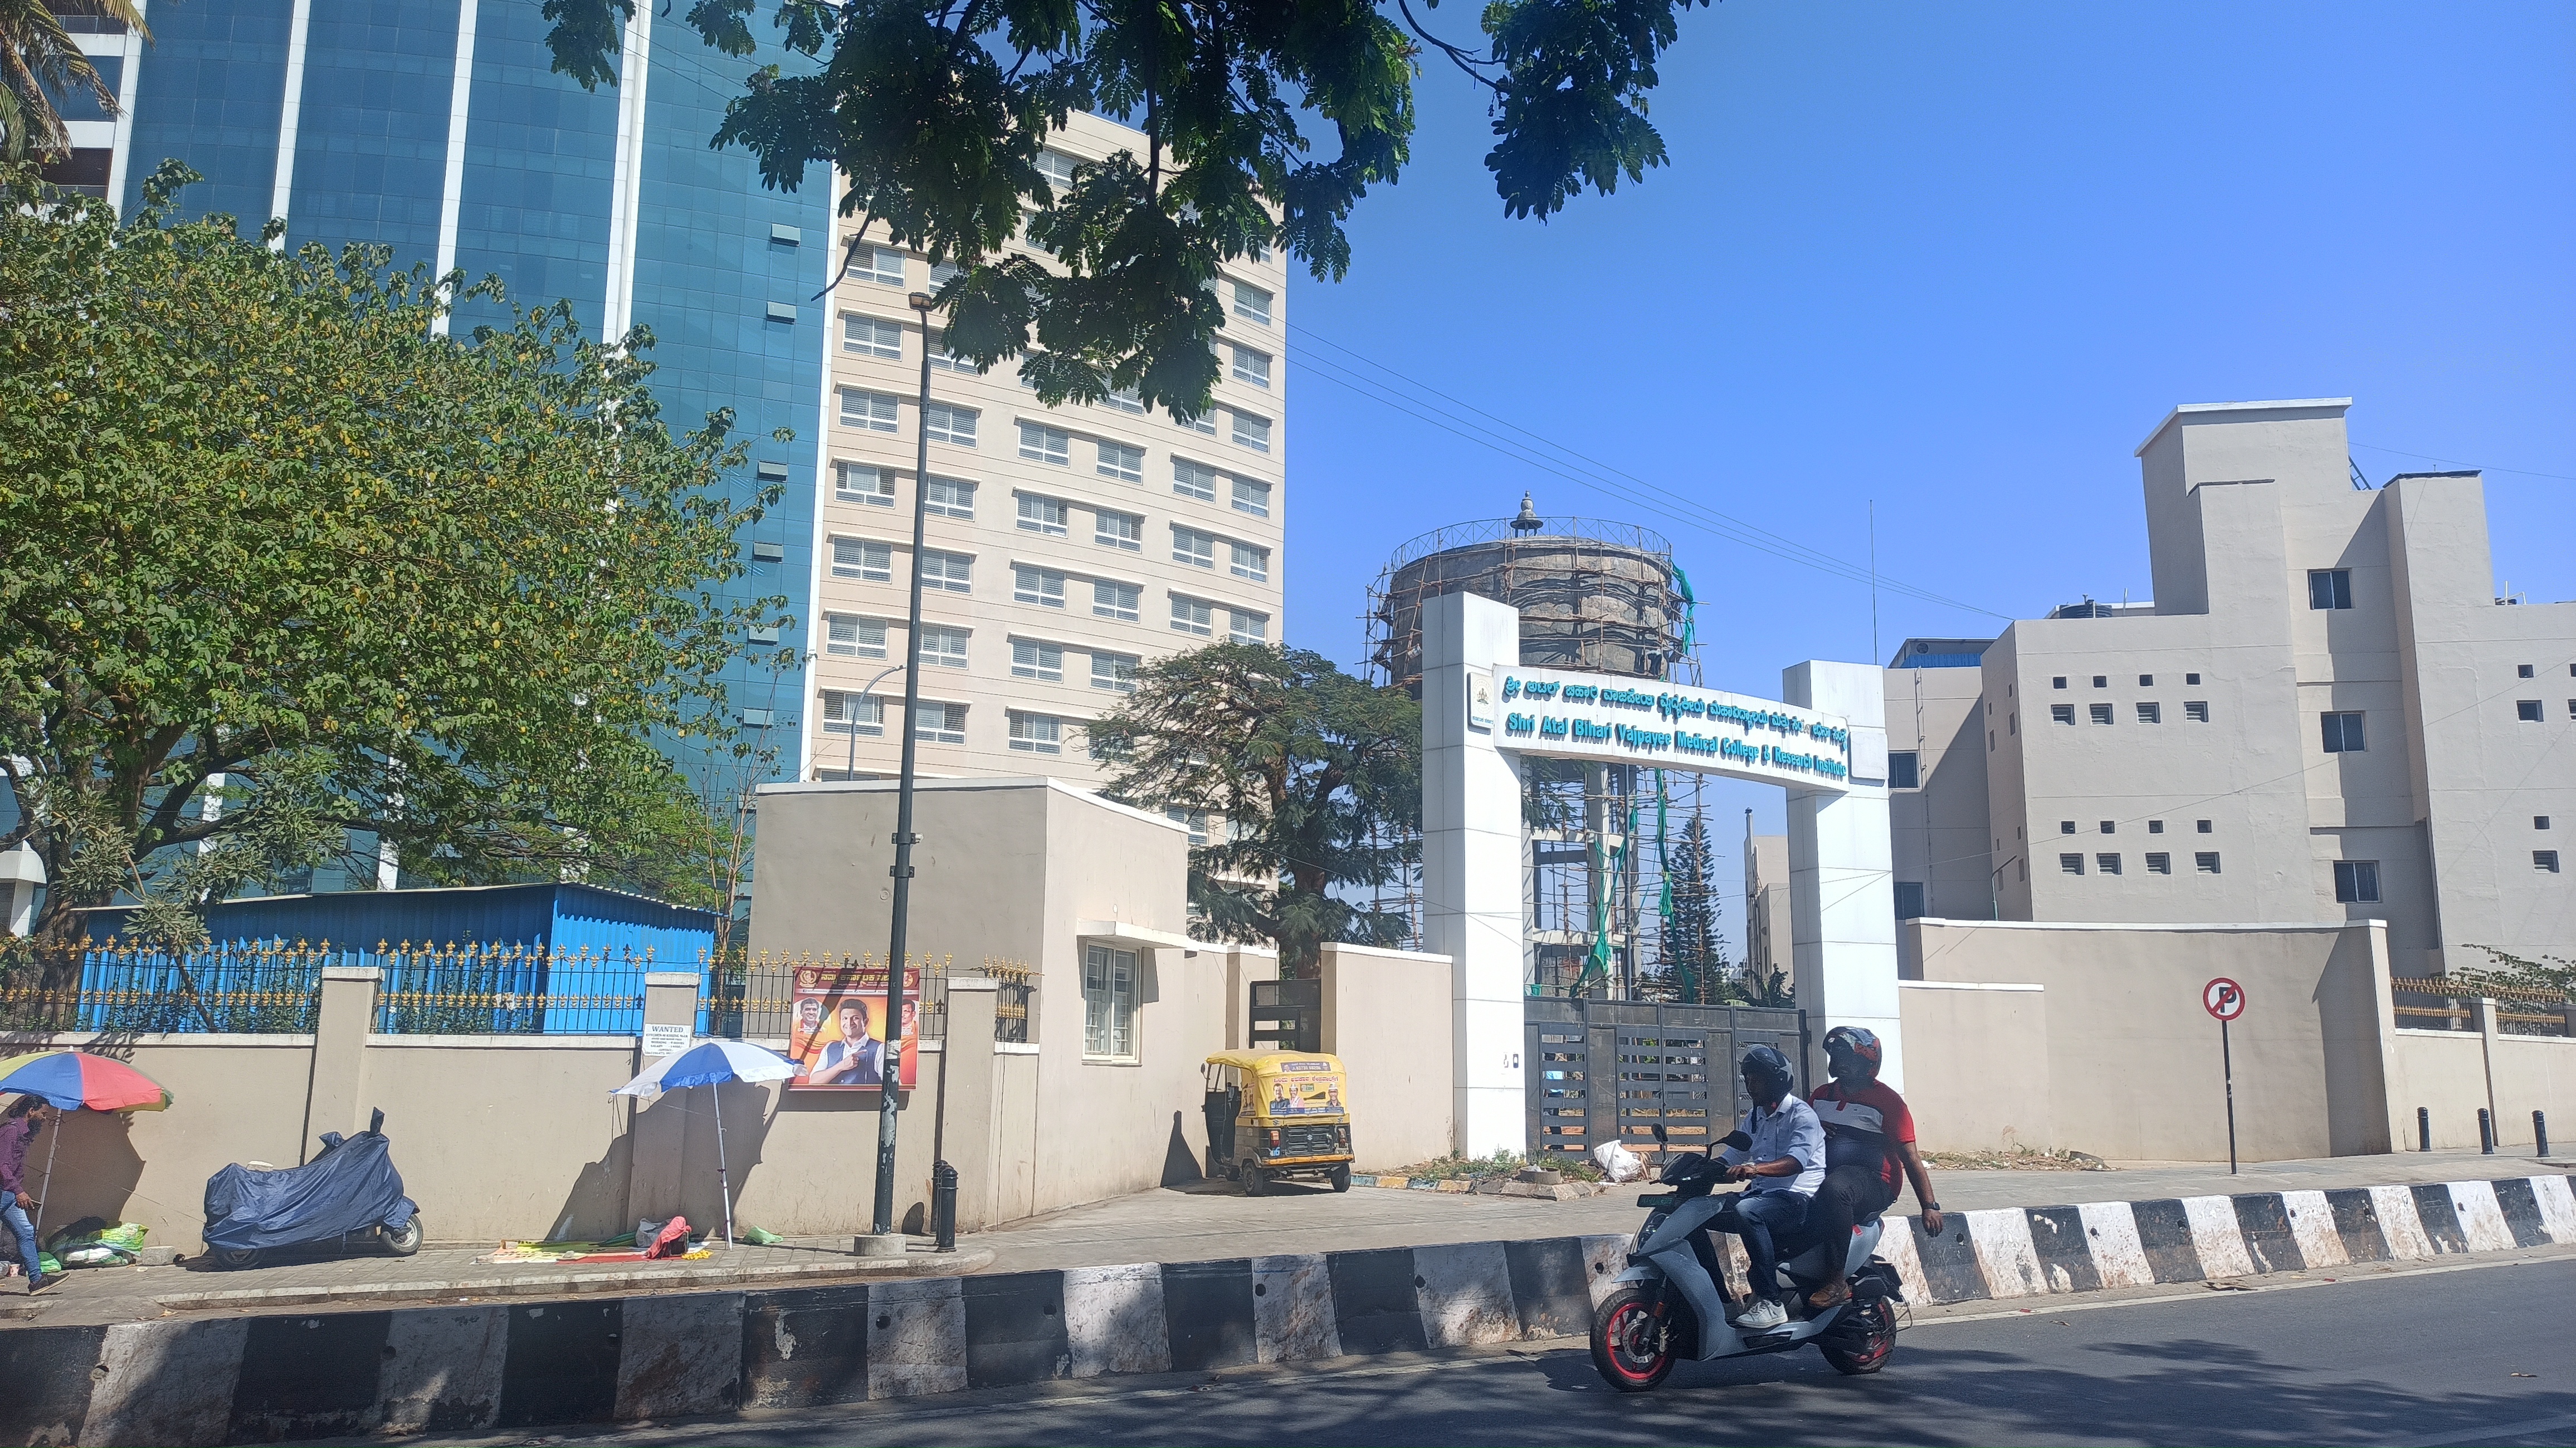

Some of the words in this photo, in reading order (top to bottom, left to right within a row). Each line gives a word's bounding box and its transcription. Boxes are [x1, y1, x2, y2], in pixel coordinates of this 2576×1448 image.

[1506, 676, 1521, 696] ಶ್ರೀ
[1527, 681, 1560, 694] ಅಟಲ್
[1565, 686, 1598, 699] ಬಿಹಾರಿ
[1603, 688, 1655, 706] ವಾಜಪೇಯಿ
[1660, 693, 1706, 718] ವೈದ್ಯಕೀಯ
[1709, 701, 1769, 730] ಮಹಾವಿದ್ಯಾಲಯ
[1509, 713, 1535, 732] Shri
[1542, 716, 1568, 735] Atal
[1575, 718, 1612, 738] Bihari
[1617, 723, 1672, 748] Vajpayee
[1677, 731, 1718, 752] Medical
[1723, 738, 1759, 761] College
[1763, 745, 1770, 760] &
[1774, 747, 1813, 769] Research
[1815, 755, 1847, 776] Institute
[2219, 987, 2236, 1012] P
